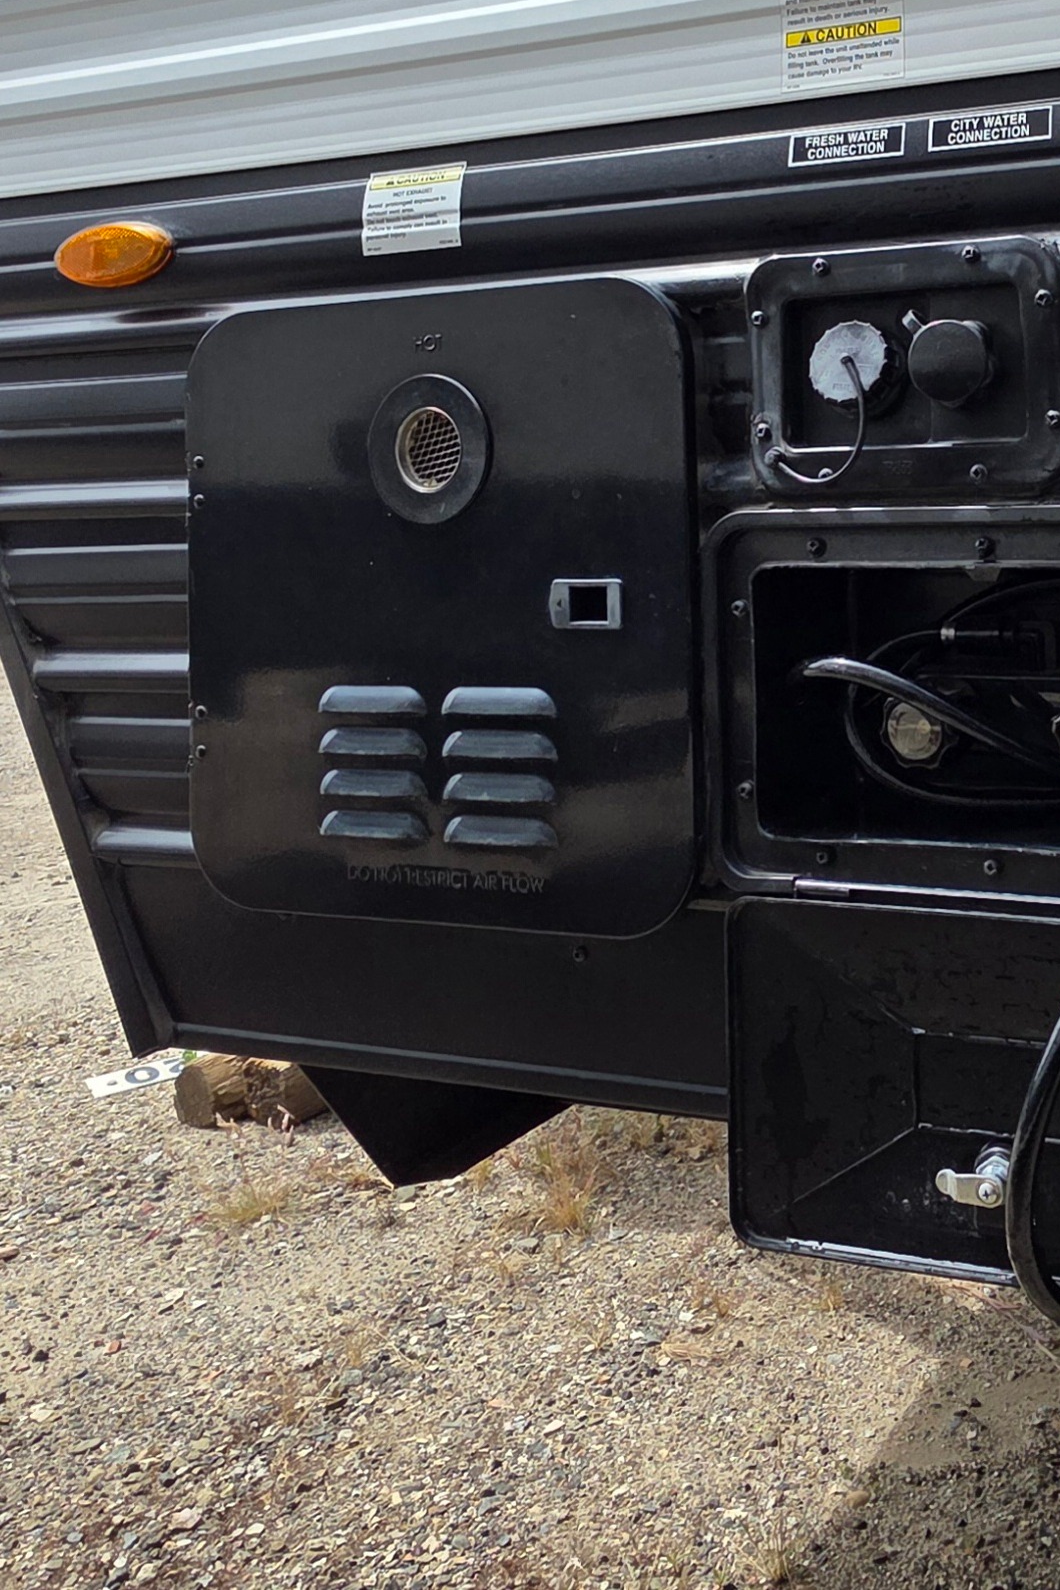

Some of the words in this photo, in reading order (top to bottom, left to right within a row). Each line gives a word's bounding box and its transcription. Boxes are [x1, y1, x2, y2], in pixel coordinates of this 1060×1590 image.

[815, 13, 833, 22] death
[844, 10, 867, 18] serious
[816, 21, 876, 42] CAUTION
[836, 45, 847, 53] unit
[839, 66, 851, 74] your
[951, 117, 979, 132] CITY
[984, 112, 1027, 127] WATER
[805, 133, 843, 149] FRESH
[848, 129, 888, 143] WATER
[947, 124, 1029, 144] CONNECTION
[807, 142, 884, 160] CONNECTION
[414, 333, 442, 352] HOT
[472, 872, 498, 891] AIR
[501, 875, 545, 895] FLOW
